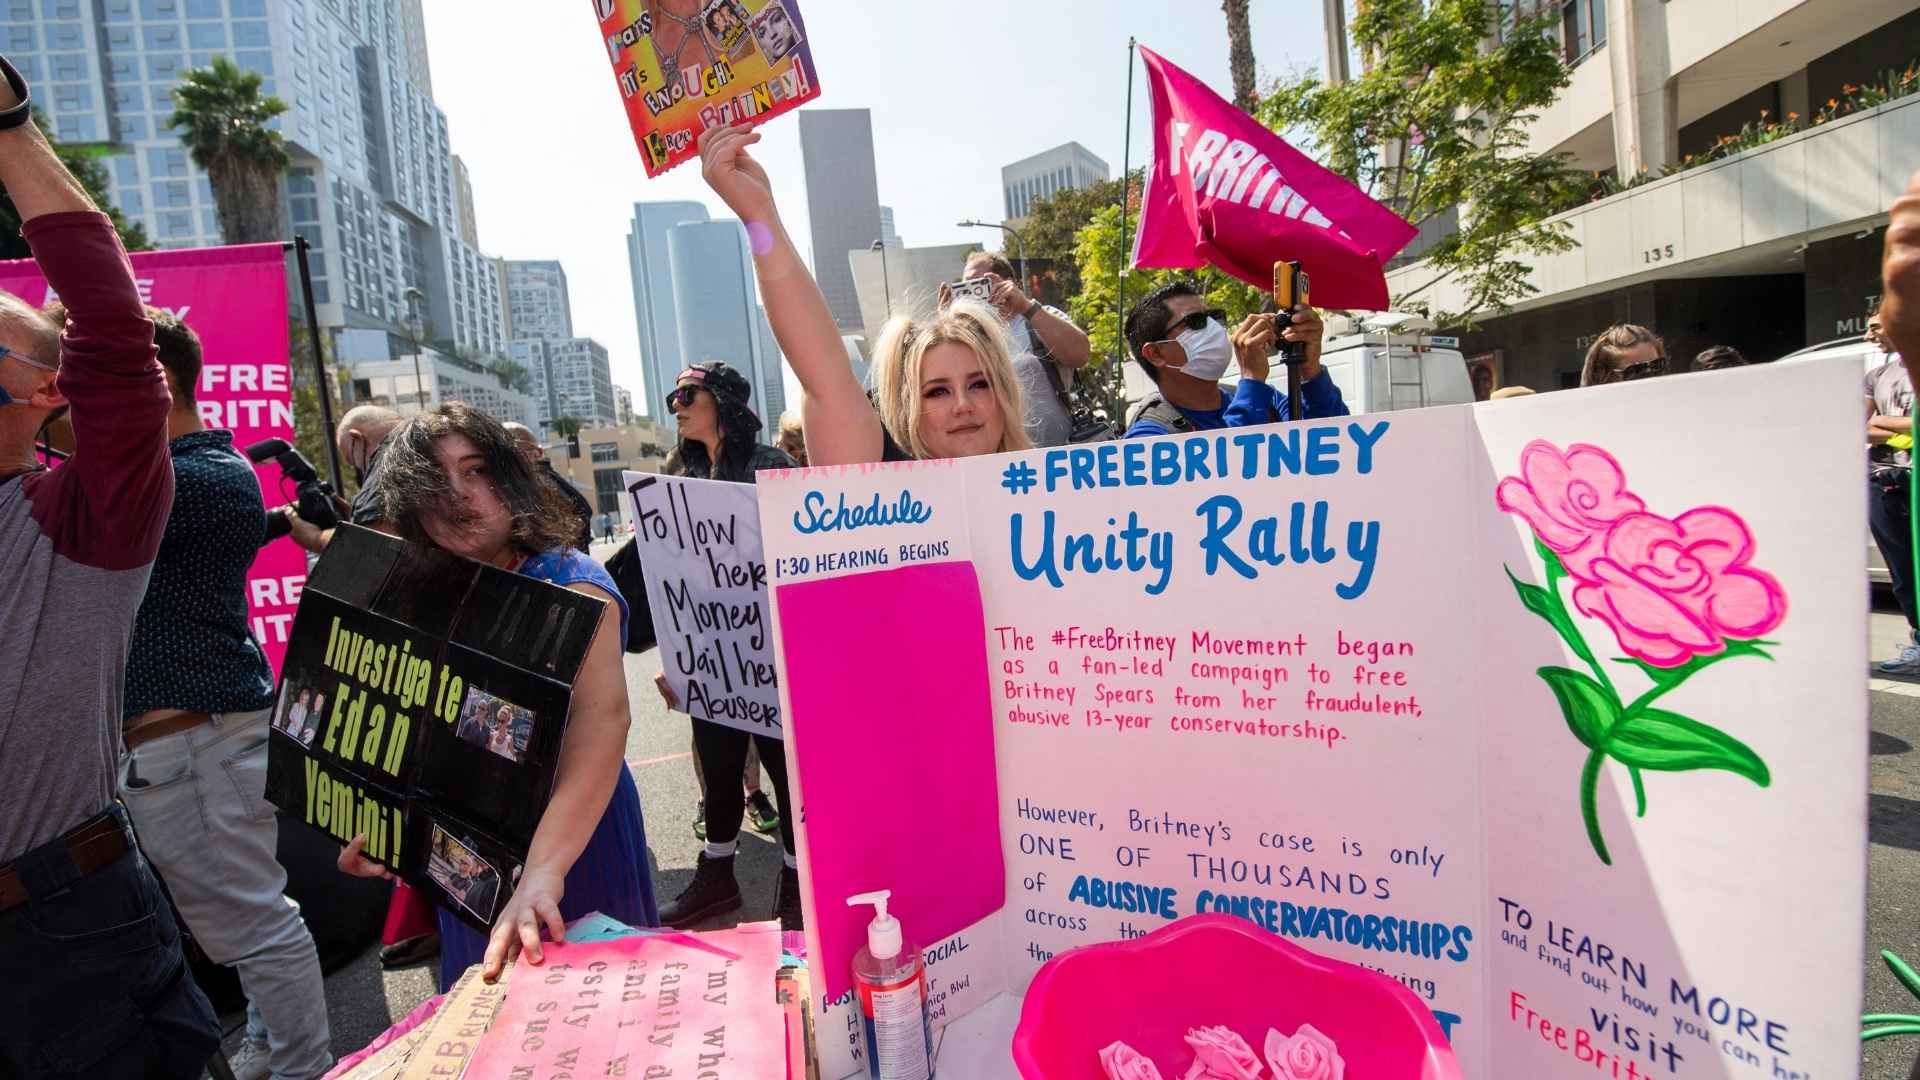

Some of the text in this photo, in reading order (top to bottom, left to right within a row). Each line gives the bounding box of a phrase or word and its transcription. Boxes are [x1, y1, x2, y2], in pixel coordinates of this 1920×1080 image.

[1644, 244, 1674, 264] 135
[202, 364, 294, 392] FRE
[197, 399, 295, 428] RITN
[1001, 421, 1390, 494] #FREEBRITNEY
[628, 477, 735, 556] Follow
[794, 489, 932, 534] Schedule
[776, 540, 950, 578] 1:30 HEARING BEGINS
[1010, 494, 1380, 600] Unity Rally
[663, 578, 764, 651] Money
[676, 634, 733, 693] Jail
[994, 626, 1414, 664] The #FreeBritney Movement began
[1003, 656, 1407, 690] as a fan-led campaign to free
[1004, 680, 1422, 718] Britney Spears from her fraudulent,
[323, 682, 411, 777] Edan
[1009, 704, 1347, 749] abusive 13-year conservatorship.
[304, 755, 402, 870] Yemini!
[1017, 798, 1445, 878] However, Britney's case is only
[1020, 833, 1391, 900] ONE OF THOUSANDS
[1024, 872, 1473, 962] of ABUSIVE CONSERVATORSHIPS
[1025, 908, 1088, 931] across
[544, 963, 573, 985] to
[622, 959, 648, 1002] and
[950, 974, 970, 995] Blvd
[1498, 897, 1790, 1055] TO LEARN MORE
[1502, 929, 1527, 951] and
[1538, 944, 1571, 976] find
[1581, 971, 1609, 993] out
[1622, 986, 1658, 1017] how
[1673, 1016, 1710, 1043] you
[1722, 1040, 1760, 1067] can
[521, 1001, 558, 1052] sue
[648, 962, 689, 1048] family
[1510, 991, 1656, 1080] FreeBrit
